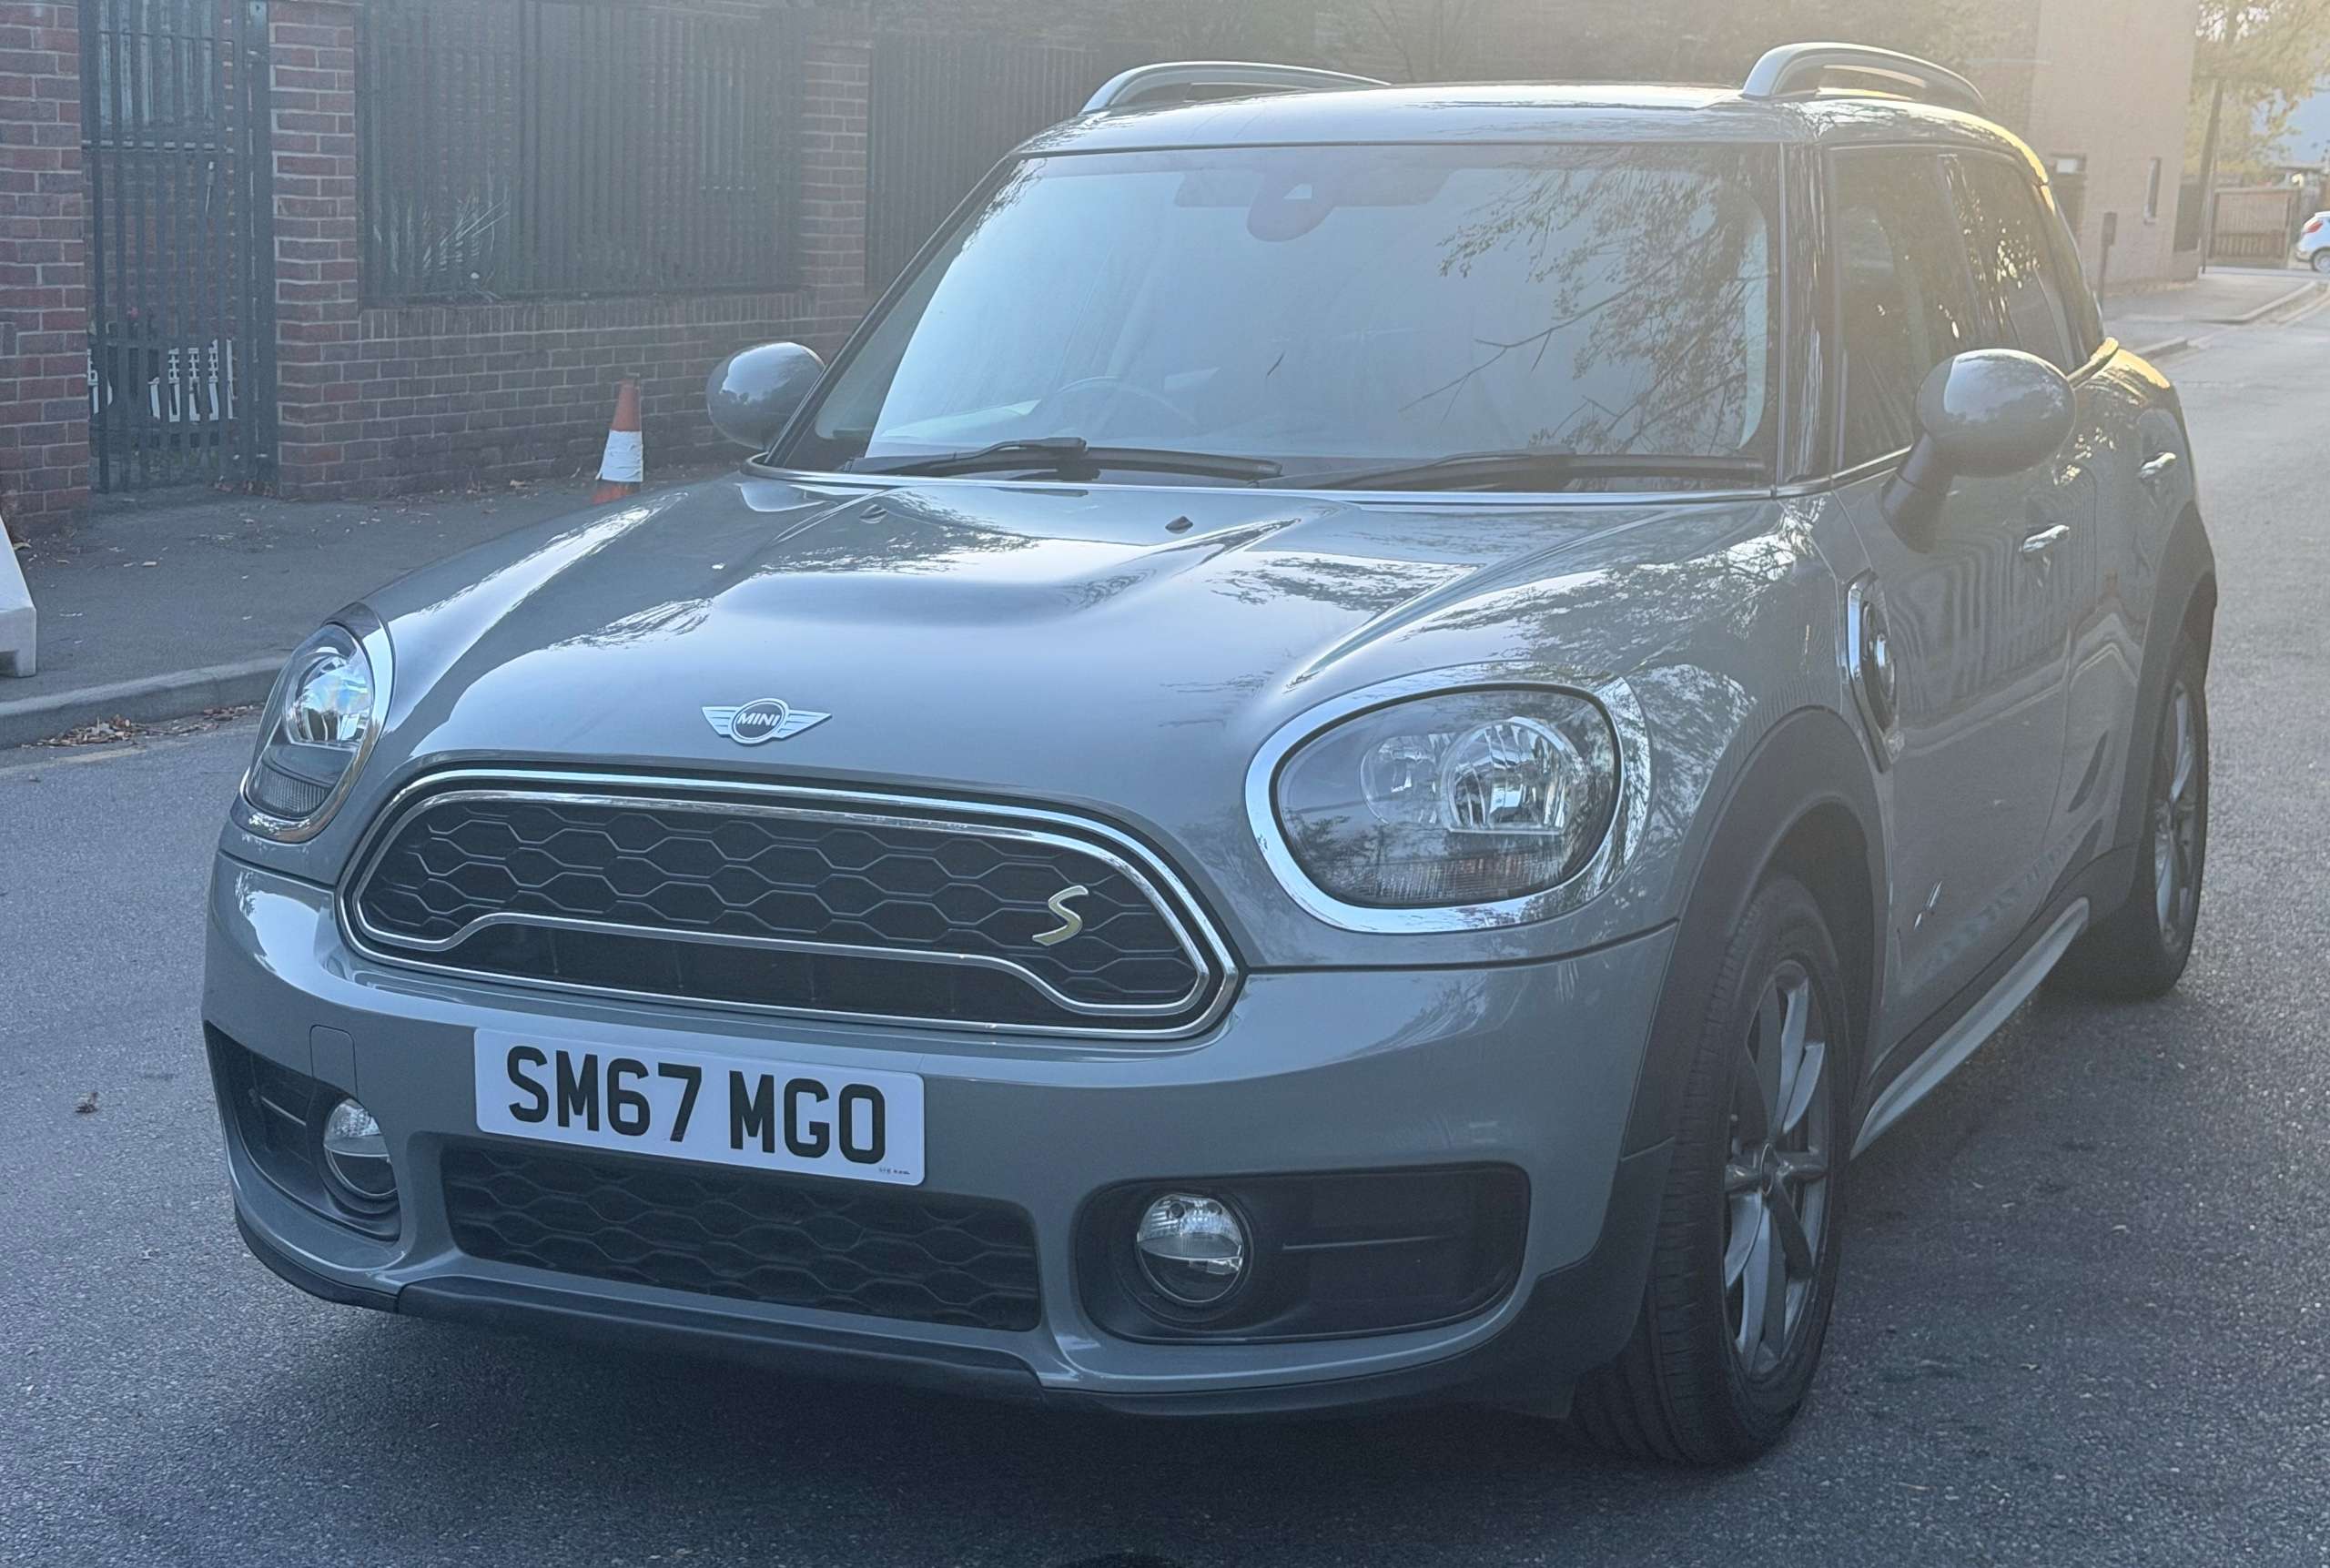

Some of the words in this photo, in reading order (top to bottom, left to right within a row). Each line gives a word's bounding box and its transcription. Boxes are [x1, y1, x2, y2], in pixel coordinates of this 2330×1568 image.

[736, 713, 780, 726] MINI
[1031, 885, 1089, 946] S
[506, 1045, 703, 1143] SM67
[729, 1069, 886, 1165] MGO
